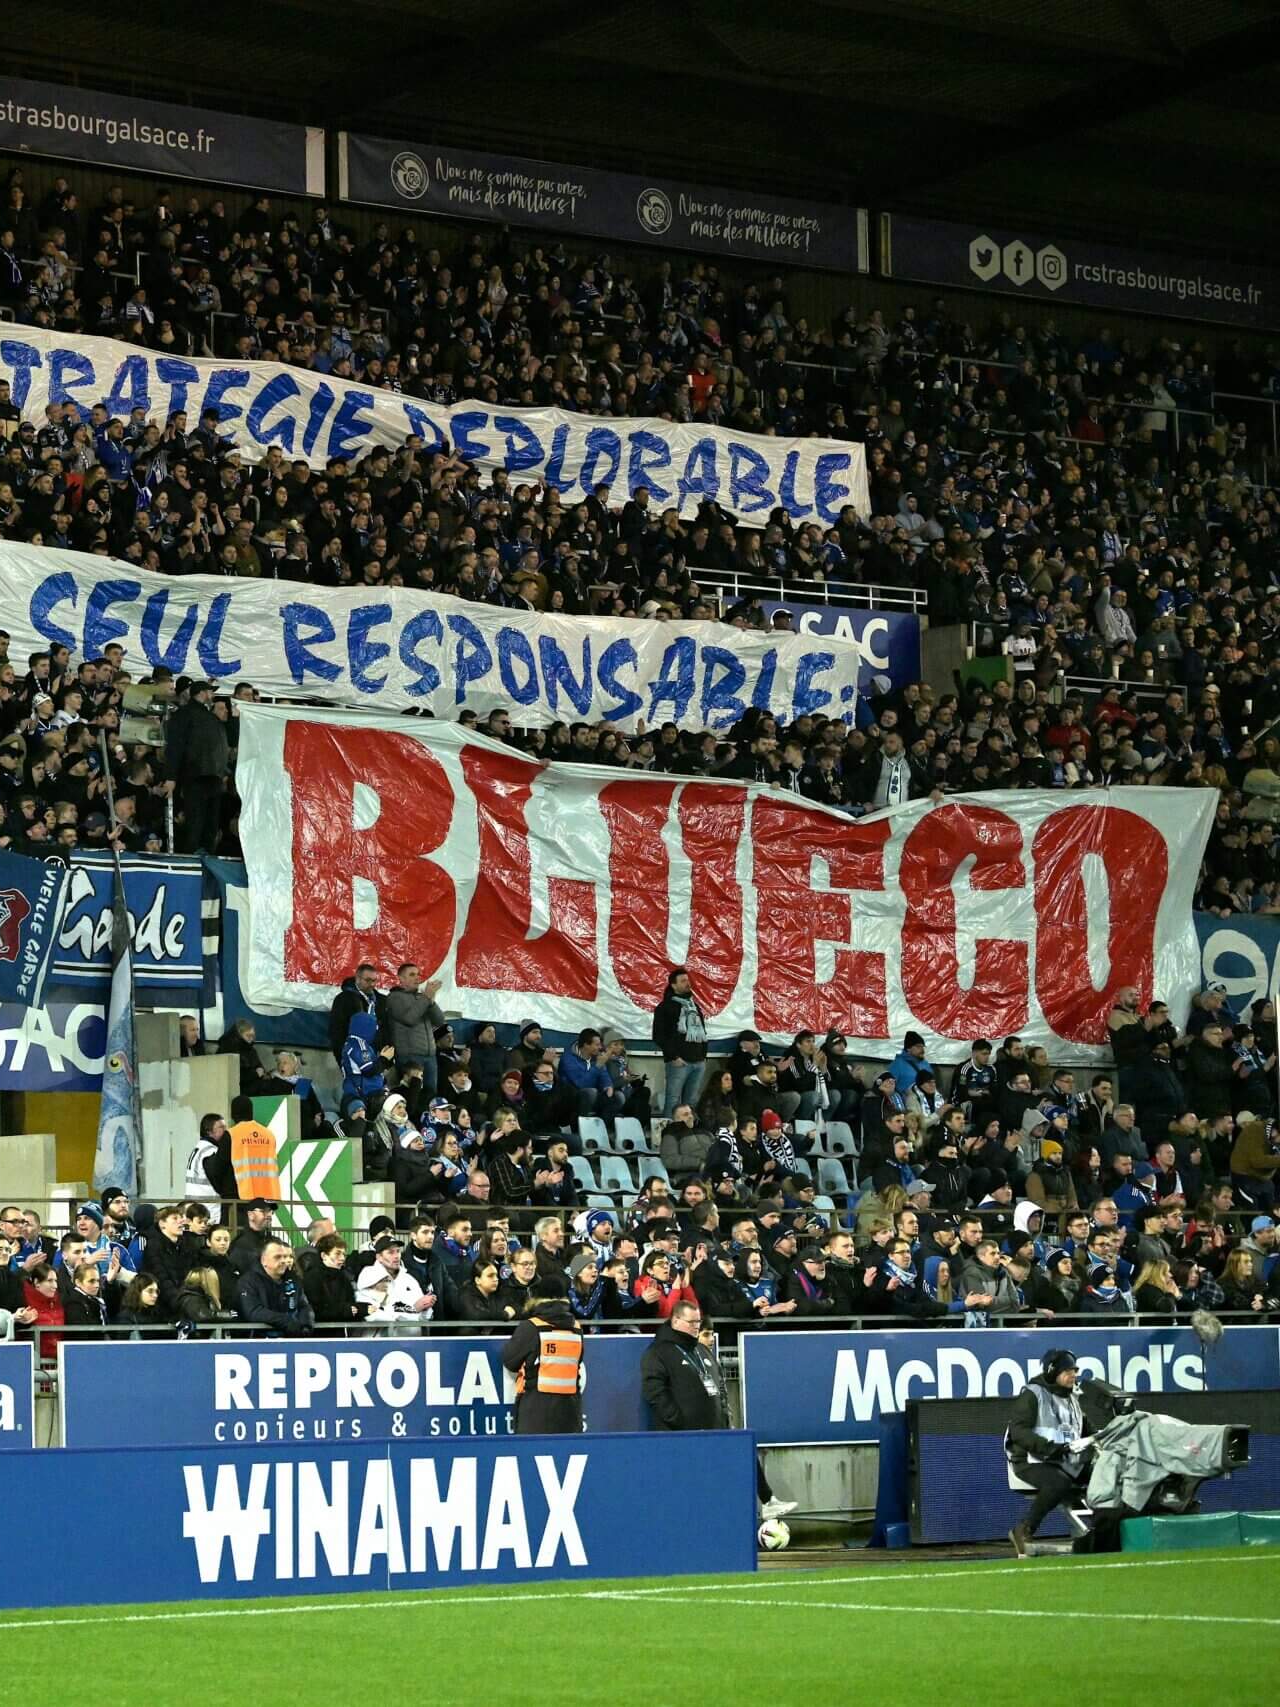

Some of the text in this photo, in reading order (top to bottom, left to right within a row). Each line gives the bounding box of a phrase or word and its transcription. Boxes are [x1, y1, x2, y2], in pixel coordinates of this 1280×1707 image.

[435, 157, 467, 181] Nous
[470, 168, 484, 183] ne
[537, 178, 555, 196] pas
[484, 185, 506, 209] des
[679, 193, 708, 216] Nous
[710, 203, 724, 218] ne
[774, 214, 790, 229] pas
[722, 221, 743, 247] des
[1074, 260, 1262, 305] rcstrasbourgalsace.fr
[30, 571, 241, 678] SEUL
[282, 717, 1168, 1046] BLUECO
[16, 869, 58, 998] VIEILLE GARDE
[545, 1343, 557, 1355] 15
[214, 1412, 363, 1444] copieurs
[391, 1411, 408, 1438] &
[182, 1453, 589, 1584] WINAMAX
